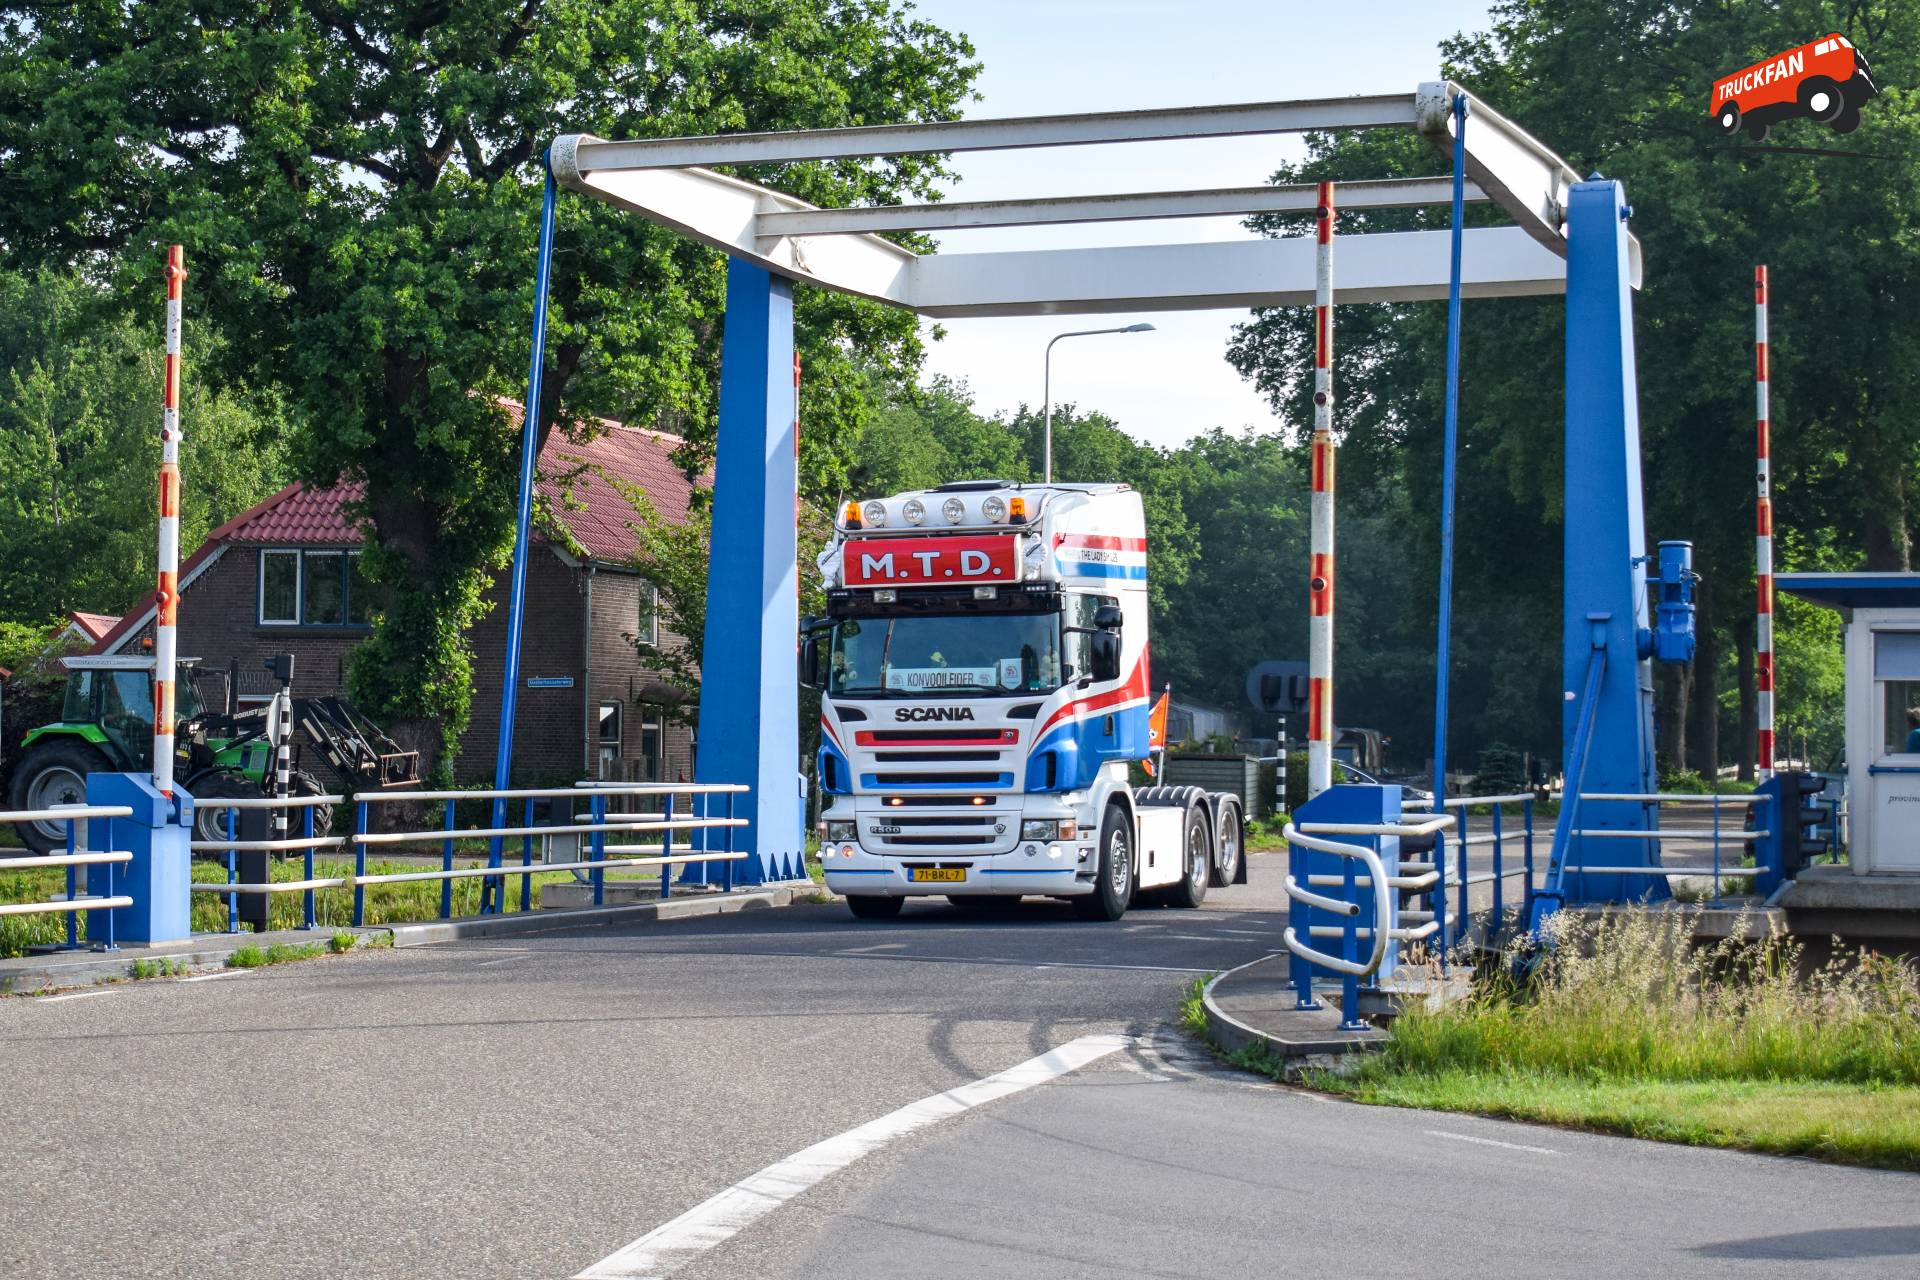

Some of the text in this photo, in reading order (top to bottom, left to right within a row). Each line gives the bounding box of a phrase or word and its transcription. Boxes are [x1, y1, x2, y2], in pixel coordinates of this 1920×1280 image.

[861, 550, 1002, 579] M.T.D.
[907, 673, 974, 687] KONVOOILEIDER
[895, 707, 975, 722] SCANIA
[919, 870, 961, 880] 71-BRL-7
